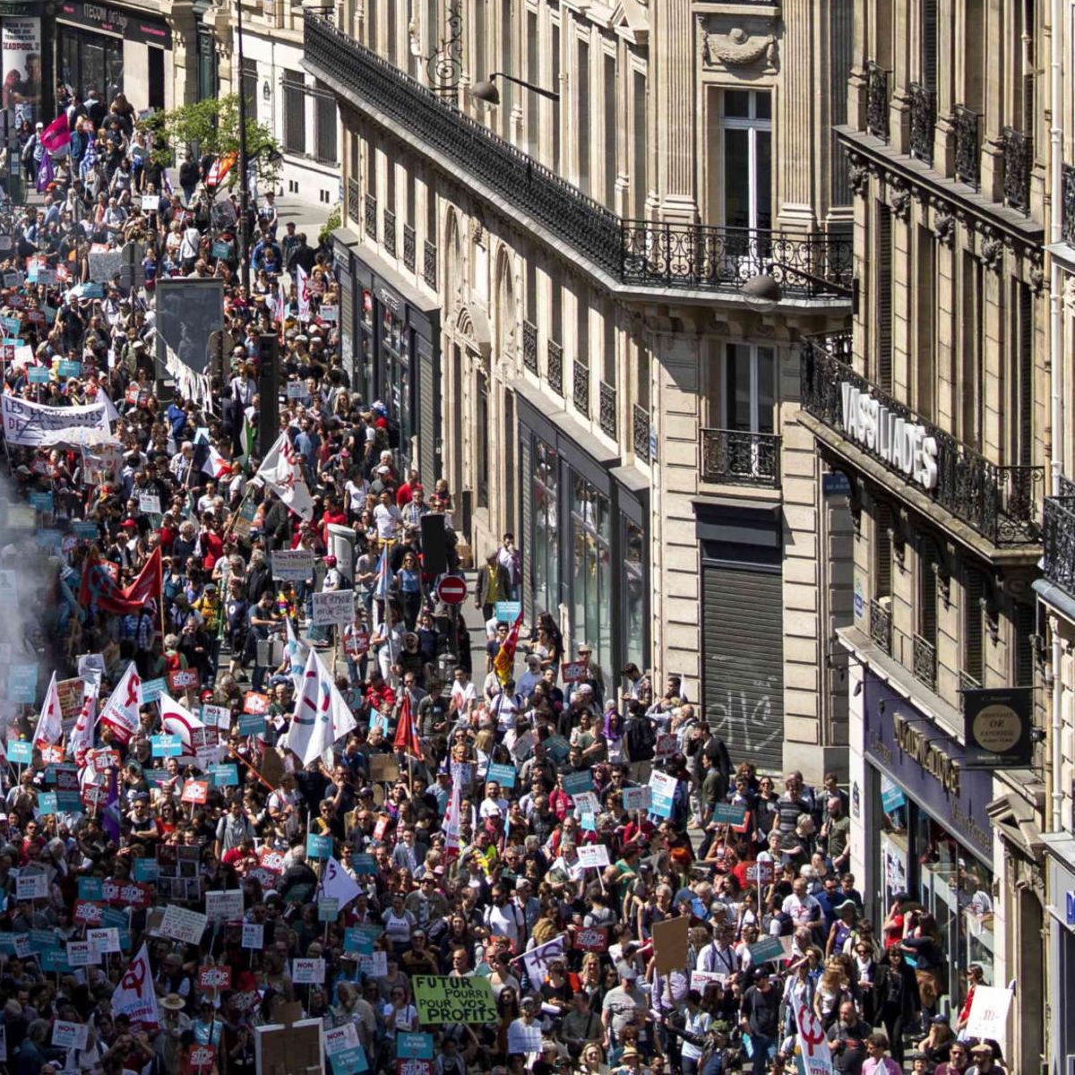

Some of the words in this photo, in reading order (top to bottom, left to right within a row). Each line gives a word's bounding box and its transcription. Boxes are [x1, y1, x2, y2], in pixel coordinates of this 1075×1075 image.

[3, 42, 34, 51] DEADPOOL
[6, 401, 23, 414] LES
[841, 382, 938, 490] VASSILIADES
[577, 932, 604, 942] STOP
[201, 971, 229, 981] STOP
[416, 976, 473, 989] FUTUR
[445, 988, 489, 999] POURRI
[420, 999, 452, 1009] POUR
[458, 999, 486, 1009] VOS
[427, 1008, 497, 1022] PROFITS
[327, 1031, 344, 1040] NON
[400, 1062, 429, 1072] STOP
